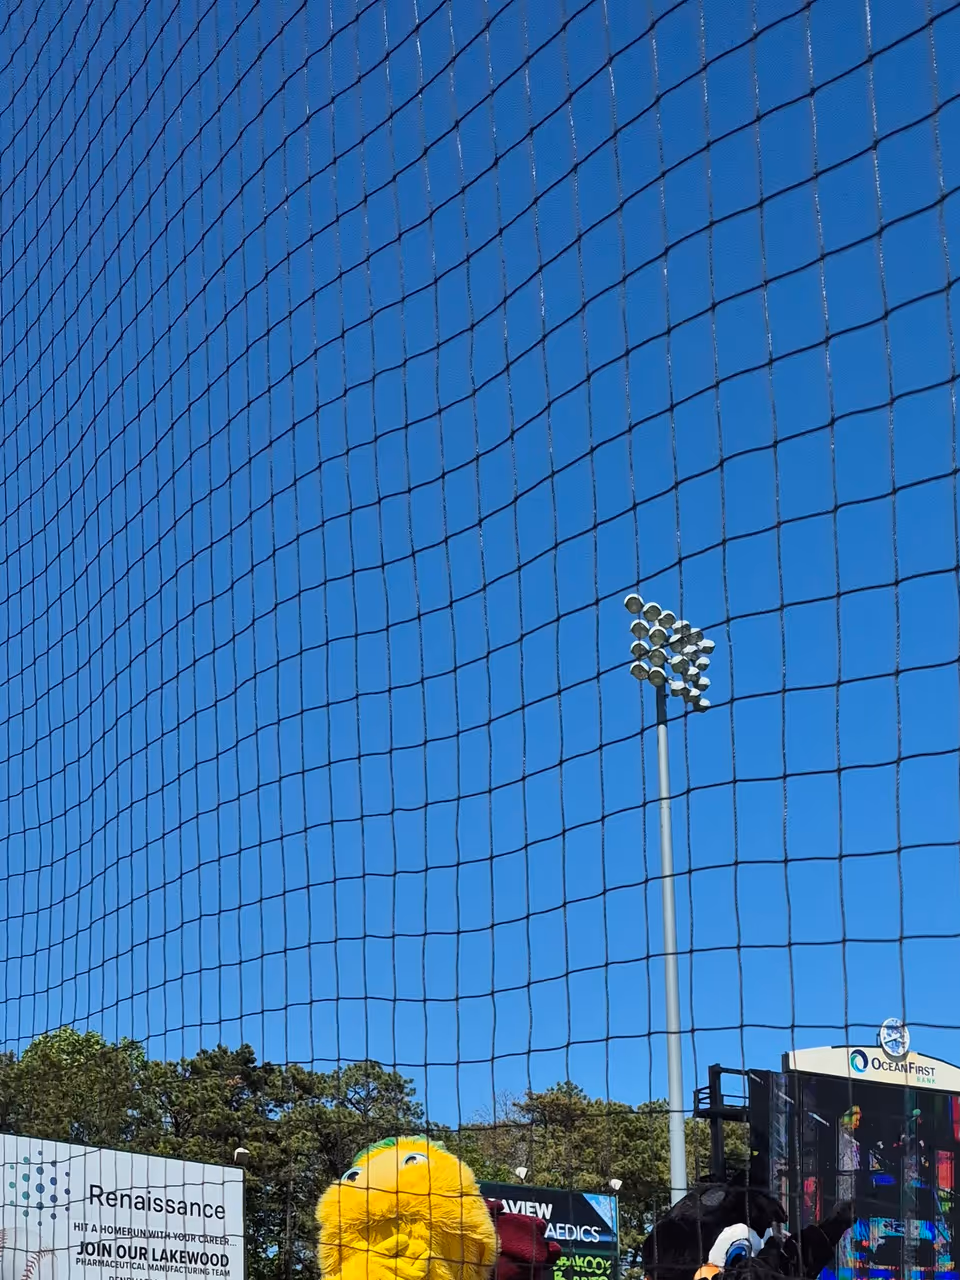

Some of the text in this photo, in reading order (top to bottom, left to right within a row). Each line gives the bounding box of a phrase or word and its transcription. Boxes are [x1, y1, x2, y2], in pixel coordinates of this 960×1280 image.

[916, 1076, 937, 1085] BANK
[89, 1184, 226, 1220] Renaissance
[500, 1199, 553, 1220] AVIEW
[73, 1222, 89, 1233] HIT
[91, 1224, 98, 1234] A
[100, 1225, 147, 1238] HOMERUN
[148, 1230, 171, 1241] WITH
[172, 1232, 197, 1243] YOUR
[543, 1222, 600, 1242] AEDICS
[76, 1240, 230, 1268] JOIN OUR LAKEWOOD
[75, 1257, 231, 1277] PHARMACEUTICAL MANUFACTURING TEAM
